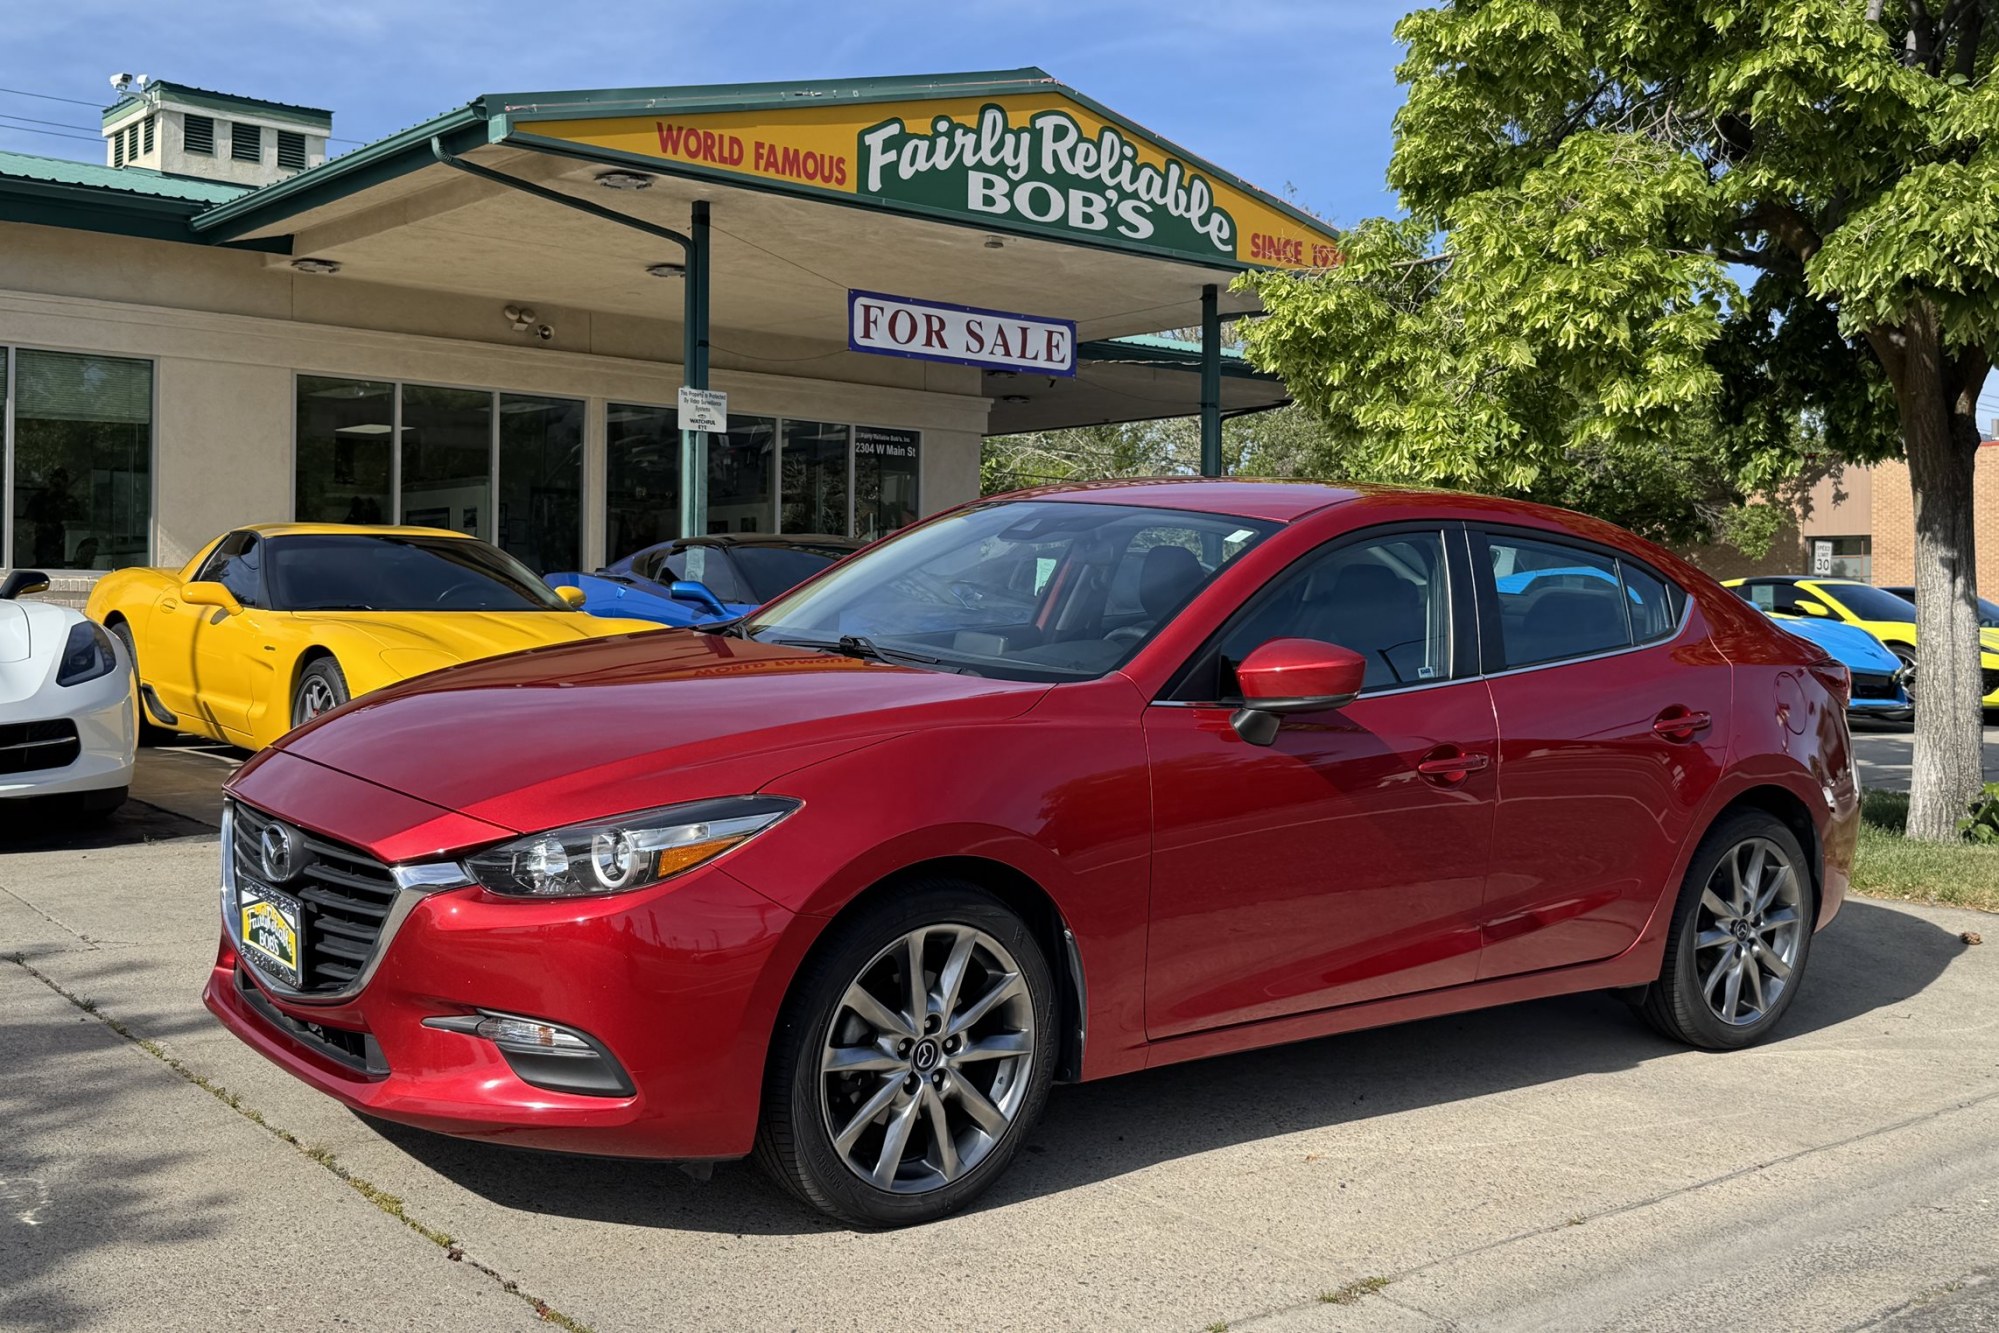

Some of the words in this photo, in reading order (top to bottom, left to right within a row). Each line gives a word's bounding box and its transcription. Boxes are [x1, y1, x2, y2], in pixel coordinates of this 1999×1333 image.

[656, 122, 744, 167] WORLD
[754, 141, 847, 186] FAMOUS
[864, 108, 1032, 193] Fairly
[1035, 114, 1233, 252] Reliable
[967, 170, 1155, 240] BOB'S
[1250, 232, 1303, 264] SINCE
[860, 303, 949, 350] FOR
[965, 319, 1067, 364] SALE
[855, 443, 874, 453] 2304
[876, 443, 885, 455] W
[886, 444, 906, 456] Main
[907, 446, 916, 457] St
[1816, 559, 1829, 570] 30
